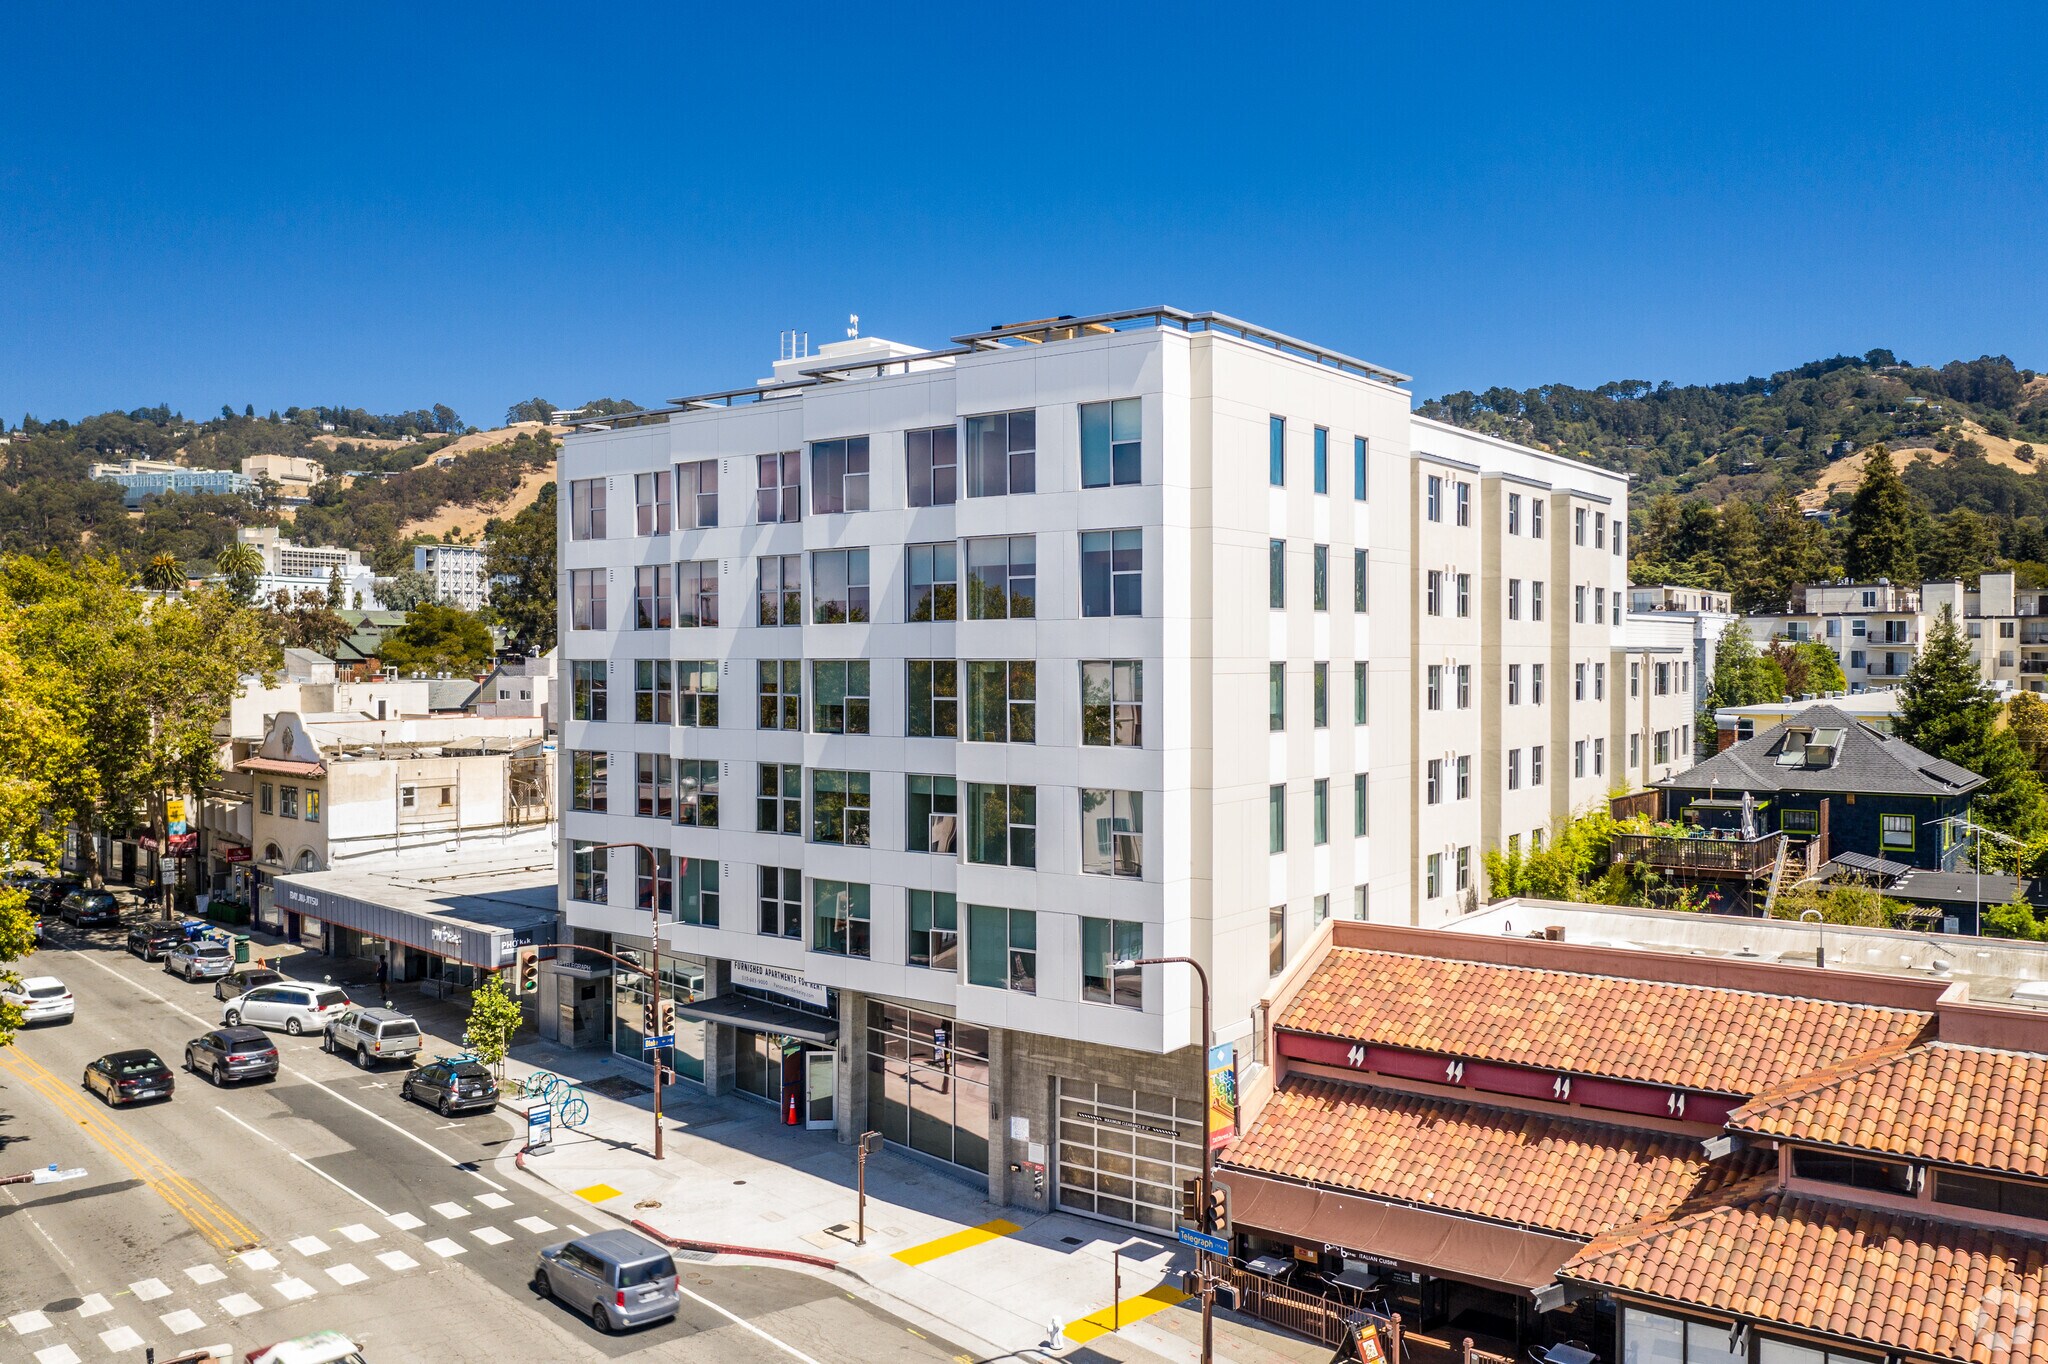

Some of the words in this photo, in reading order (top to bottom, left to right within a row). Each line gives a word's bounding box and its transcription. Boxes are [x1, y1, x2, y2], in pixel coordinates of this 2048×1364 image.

[289, 891, 298, 900] BAY
[734, 961, 763, 975] FURNISHED
[765, 968, 797, 984] APARTMENTS
[1180, 1230, 1214, 1248] Telegraph
[1358, 1253, 1378, 1262] ITALIAN
[1378, 1257, 1398, 1267] CUISINE
